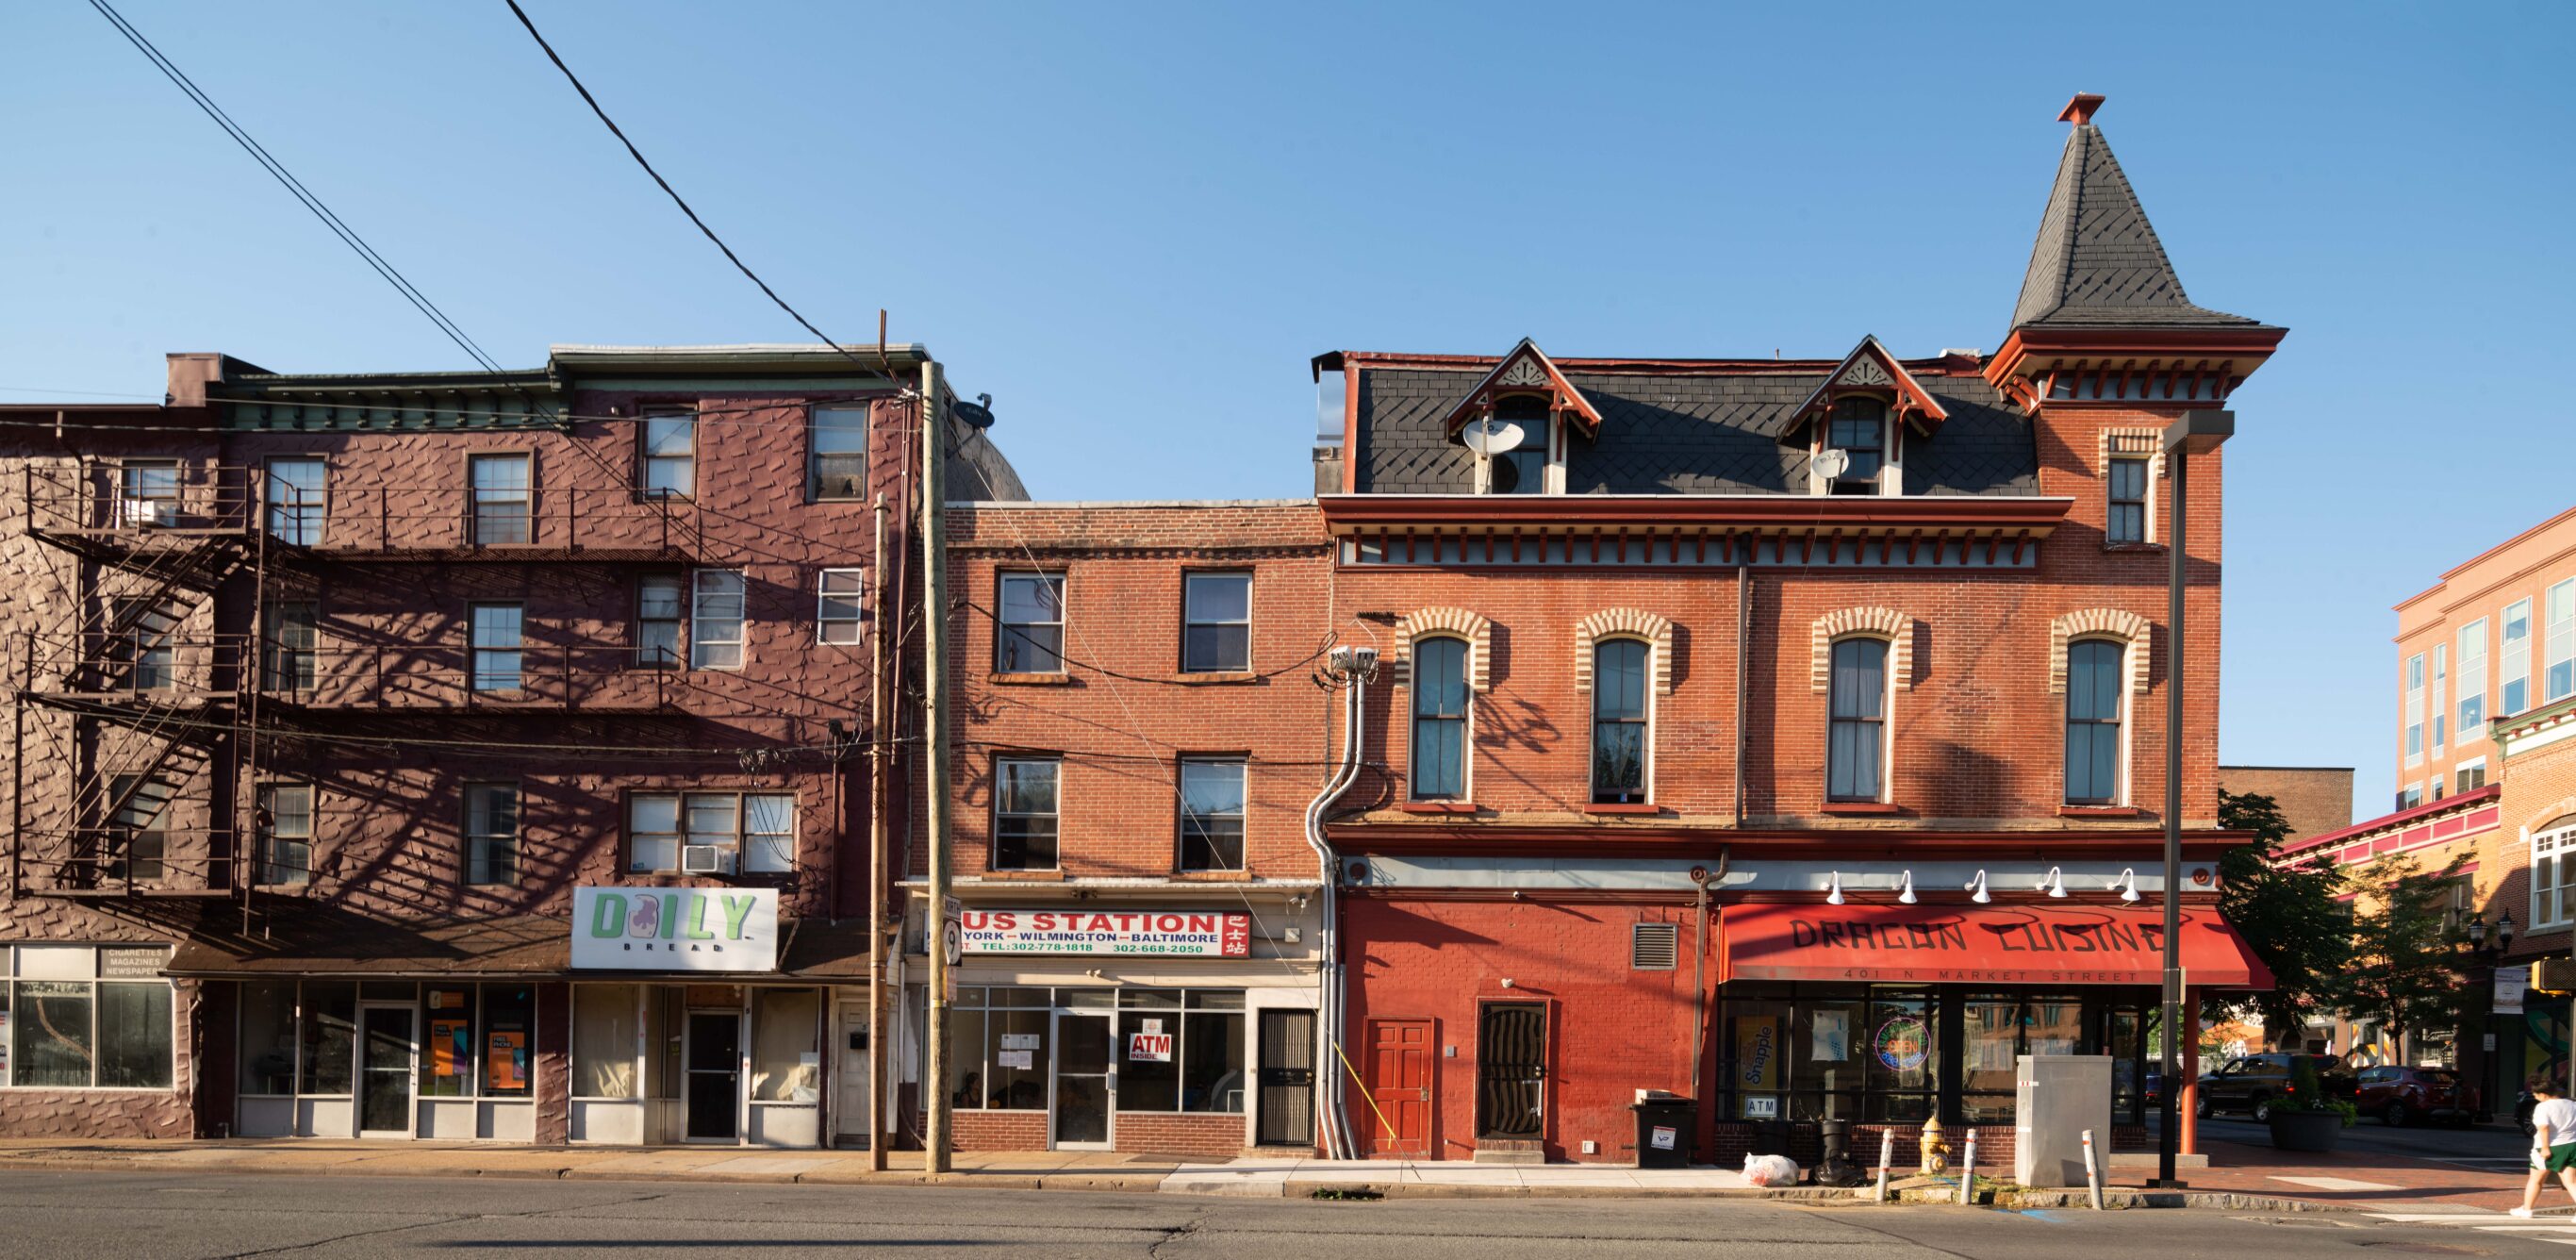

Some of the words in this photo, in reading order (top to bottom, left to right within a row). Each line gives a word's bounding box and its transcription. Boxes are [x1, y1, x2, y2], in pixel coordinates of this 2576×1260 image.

[962, 912, 1016, 931] US
[1032, 913, 1215, 933] STATION
[964, 932, 1004, 940] YORK
[1020, 933, 1116, 941] WILMINGTON
[1131, 934, 1218, 943] BALTIMORE
[1226, 915, 1247, 954] 巴士站
[1790, 920, 1967, 951] DRAGON
[1992, 922, 2164, 952] CUISINE
[623, 943, 723, 952] BREAD
[948, 930, 956, 954] 9
[982, 943, 1093, 952] TEL:302-778-1818
[1114, 944, 1203, 953] 302-668-2050
[108, 949, 162, 957] CIGARETTES
[1940, 971, 2025, 980] MARKET
[2052, 972, 2137, 981] STREET
[1131, 1036, 1170, 1053] ATM
[1888, 1040, 1919, 1053] OPEN
[1745, 1026, 1773, 1085] Snapple
[1748, 1101, 1774, 1112] ATM
